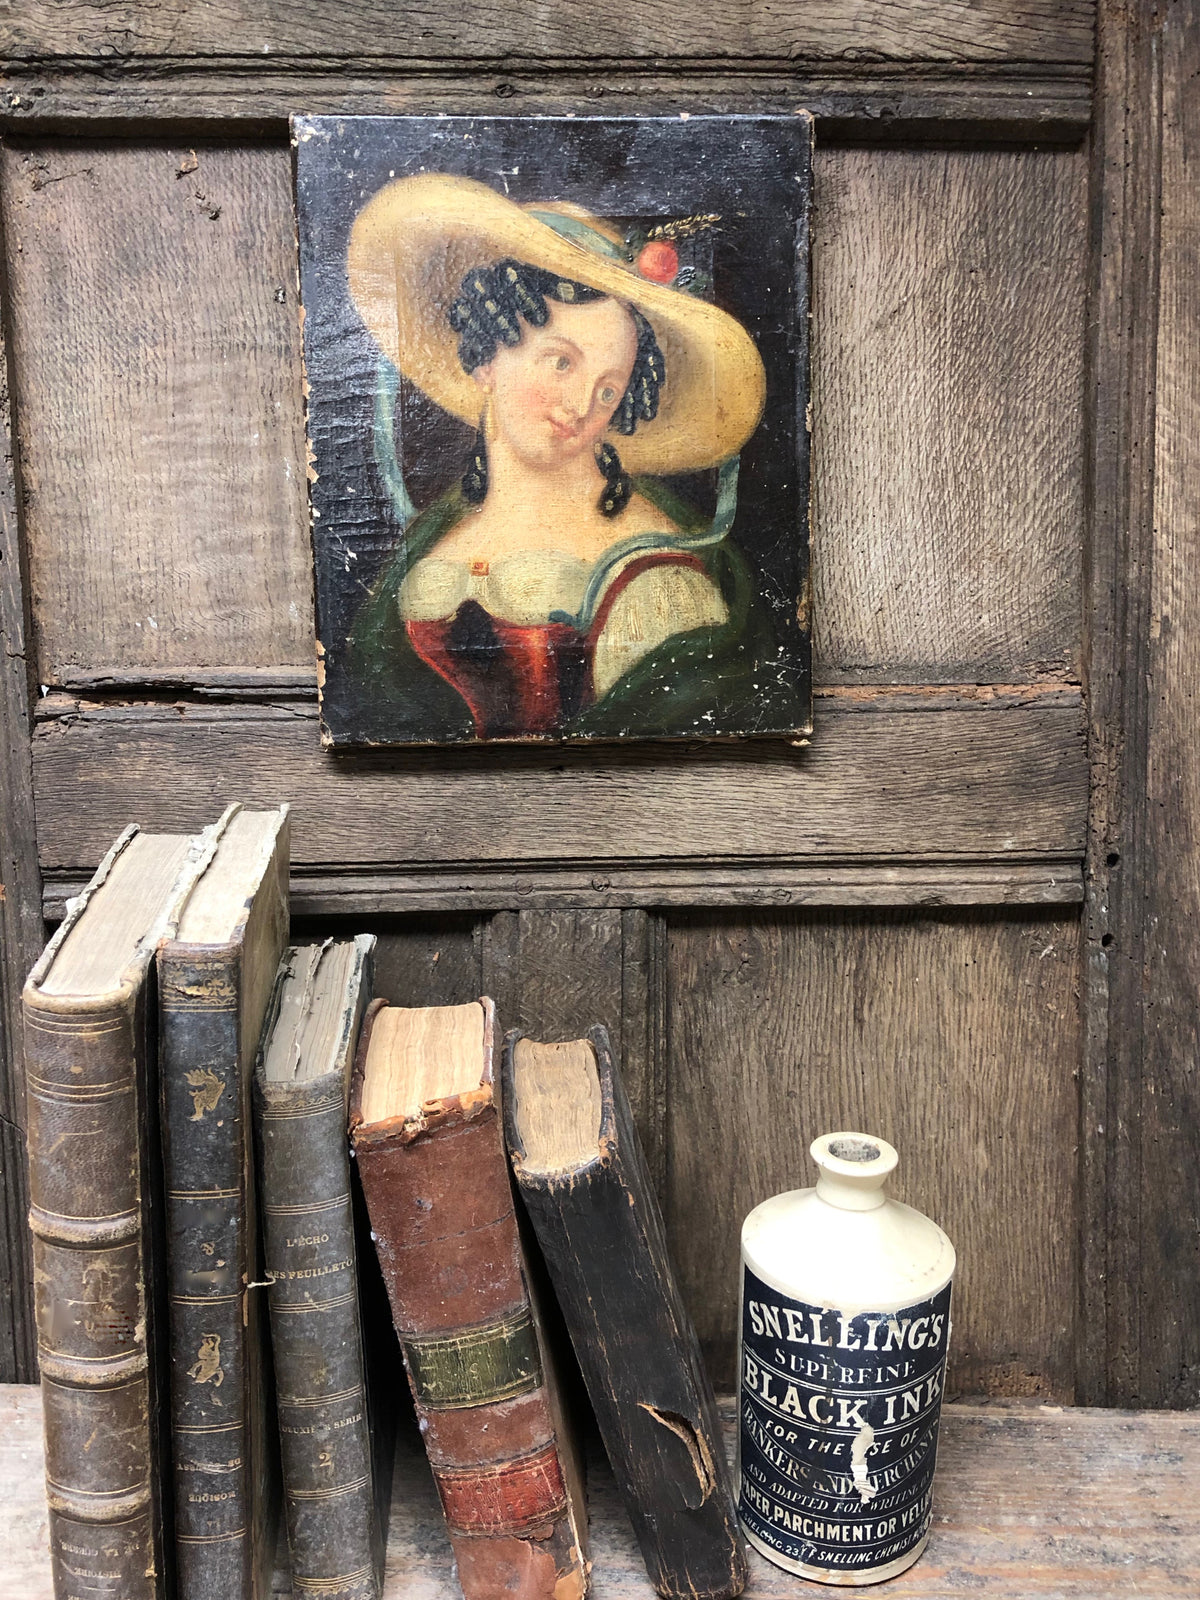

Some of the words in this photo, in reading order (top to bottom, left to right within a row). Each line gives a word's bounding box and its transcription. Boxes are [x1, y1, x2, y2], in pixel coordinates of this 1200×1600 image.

[266, 1269, 286, 1280] ES
[749, 1300, 944, 1352] SNELLING'S
[774, 1348, 916, 1385] SUPERFINE
[745, 1355, 868, 1428] BLACK
[883, 1366, 942, 1426] INK
[765, 1420, 798, 1444] FOR
[808, 1438, 845, 1456] THE
[860, 1440, 893, 1456] SE
[900, 1428, 919, 1447] OF
[319, 1452, 333, 1468] 2
[747, 1464, 767, 1483] AND
[769, 1482, 829, 1511] ADAPTED
[833, 1502, 863, 1514] FOR
[877, 1517, 897, 1539] OR
